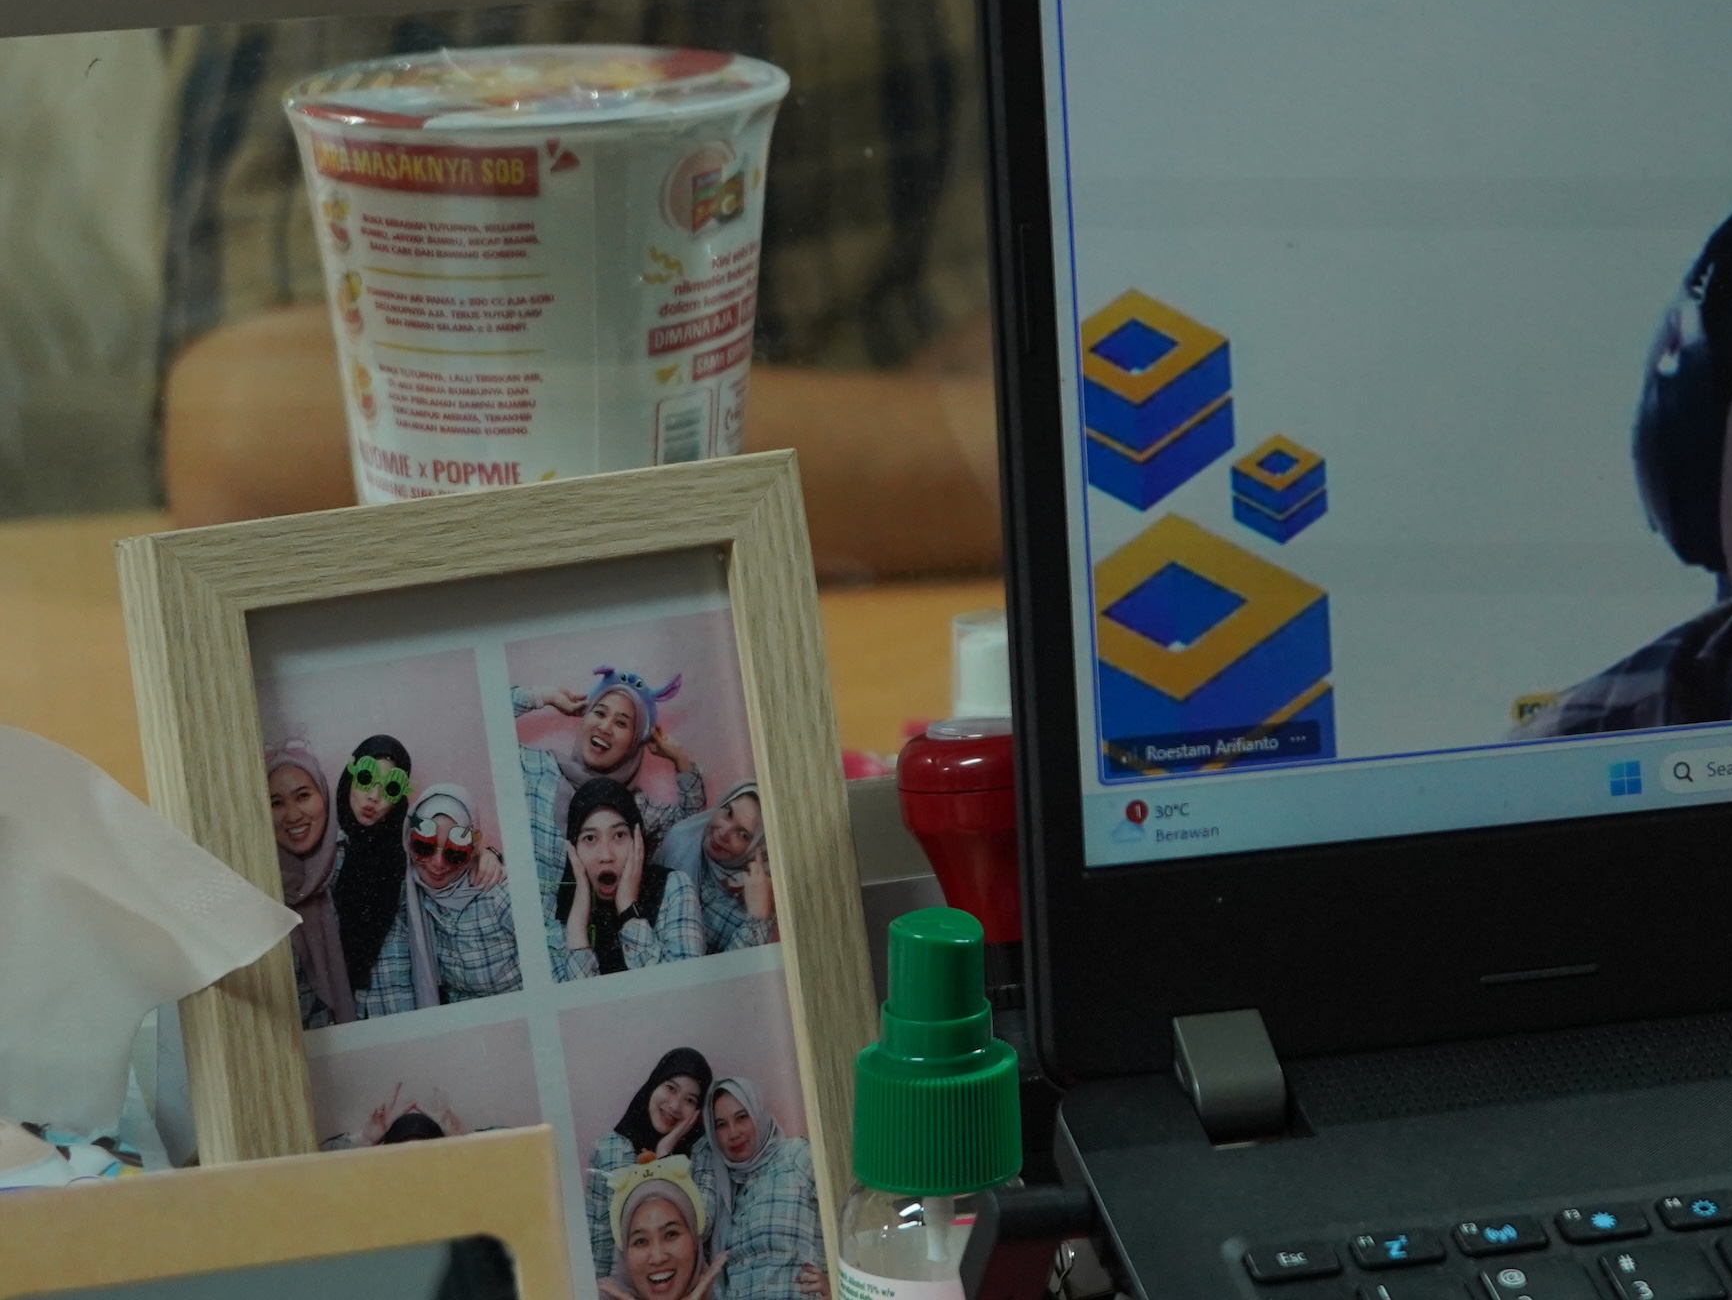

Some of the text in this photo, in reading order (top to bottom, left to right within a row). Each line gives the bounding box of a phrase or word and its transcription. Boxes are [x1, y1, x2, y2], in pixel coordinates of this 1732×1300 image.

[352, 149, 474, 185] MASAKNYA
[480, 157, 526, 186] SOB
[433, 459, 522, 485] POPMIE
[1146, 743, 1211, 763] Roestam
[1155, 802, 1190, 819] 30°C
[1156, 825, 1220, 843] Berawan
[1664, 1197, 1681, 1209] F4
[1565, 1208, 1582, 1221] F3
[1461, 1222, 1479, 1235] F2
[1356, 1235, 1376, 1249] F1
[1276, 1251, 1307, 1268] Esc
[1618, 1253, 1636, 1273] #
[1496, 1268, 1527, 1289] @
[1631, 1280, 1654, 1300] 3
